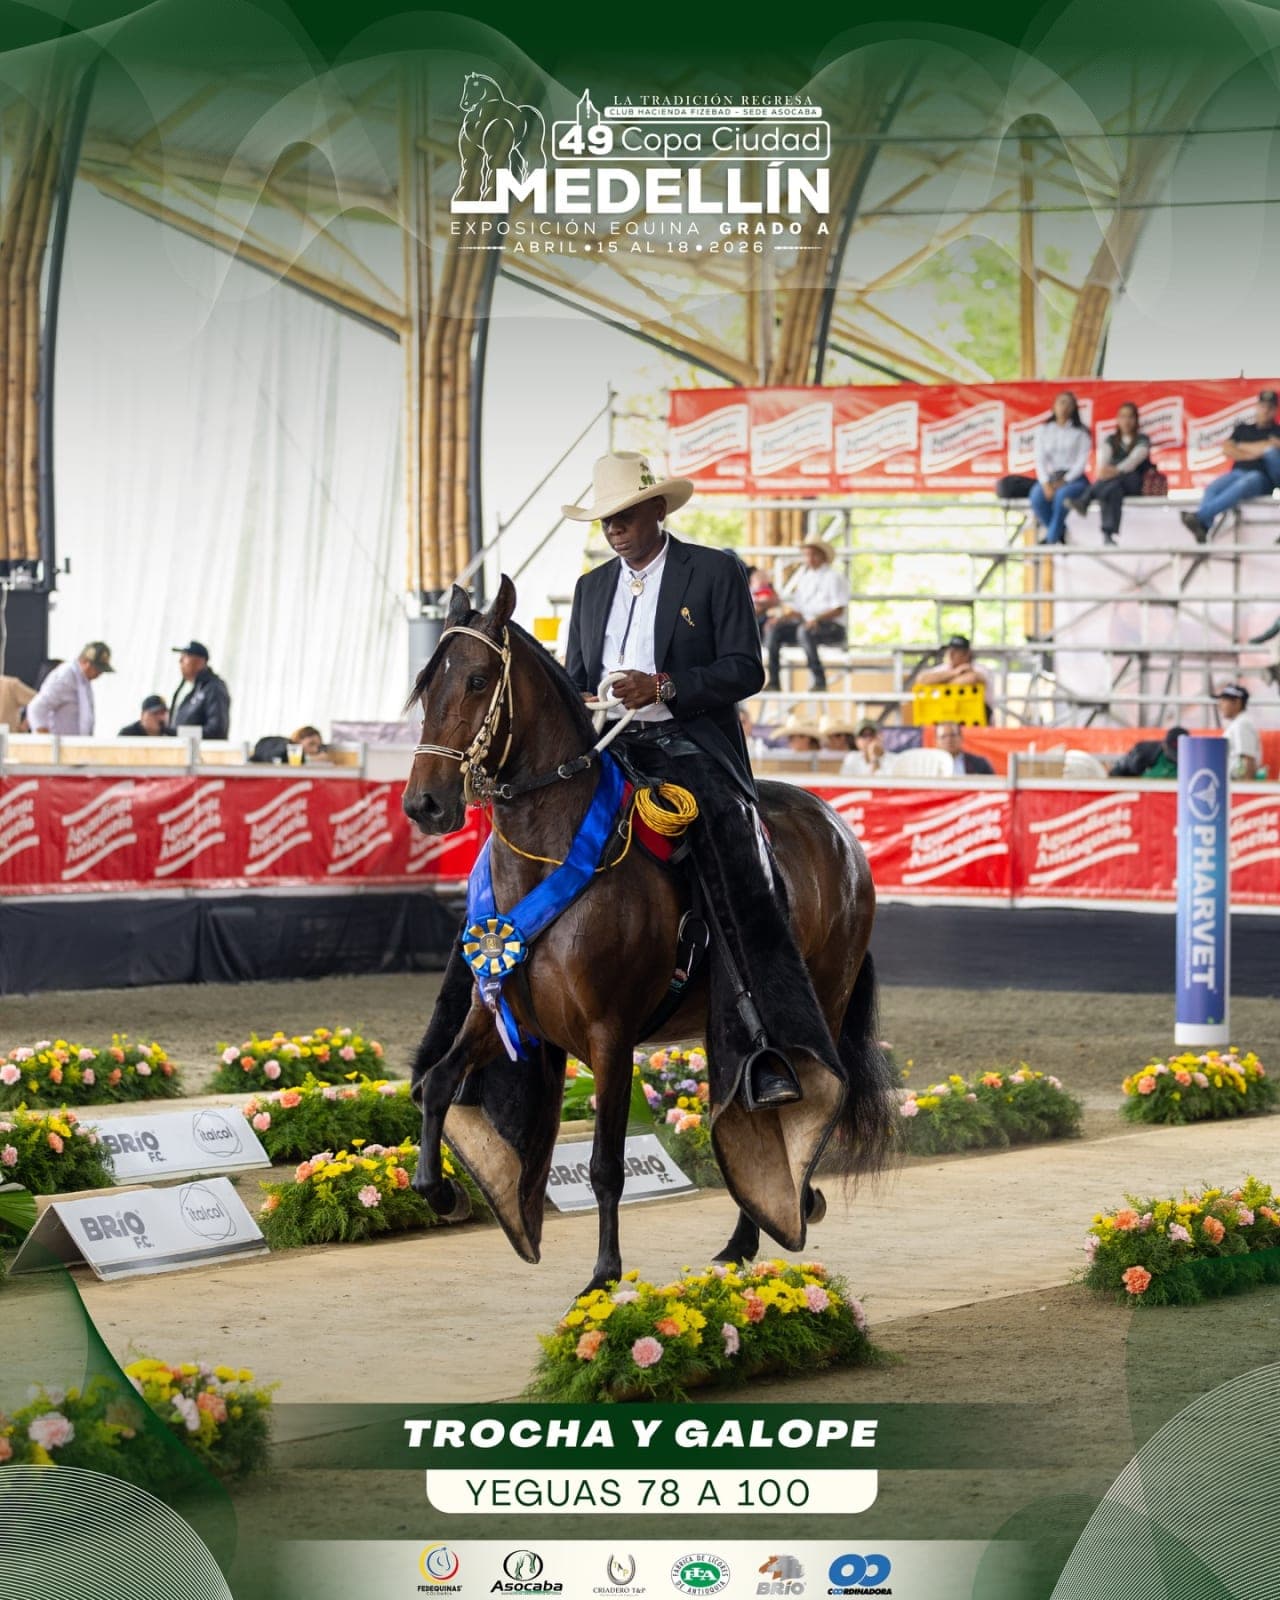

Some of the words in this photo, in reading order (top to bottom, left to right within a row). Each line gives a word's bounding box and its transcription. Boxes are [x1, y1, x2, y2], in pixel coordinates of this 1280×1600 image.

[1192, 825, 1216, 991] PHARVET
[197, 1126, 233, 1142] italcol
[186, 1202, 225, 1223] italcol
